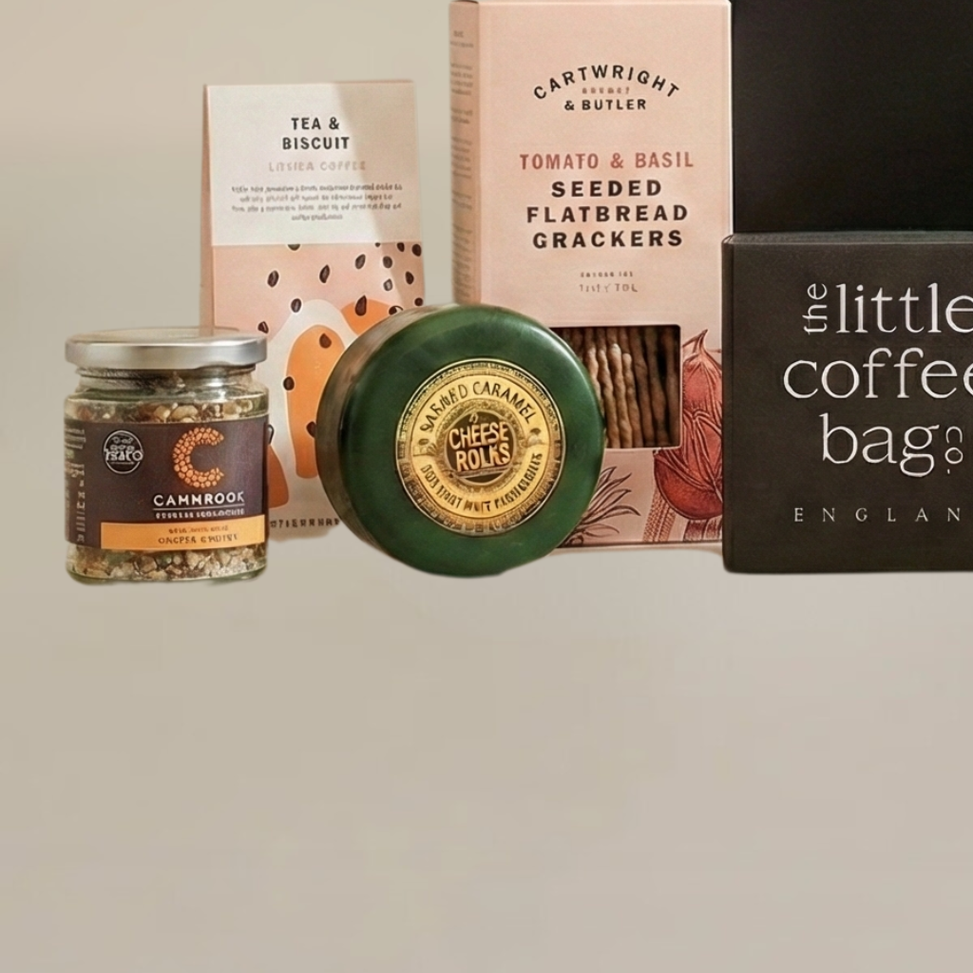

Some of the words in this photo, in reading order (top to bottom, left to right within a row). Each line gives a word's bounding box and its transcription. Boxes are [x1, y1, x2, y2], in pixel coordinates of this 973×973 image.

[533, 64, 680, 100] CARTWRIGHT
[564, 100, 575, 111] &
[581, 99, 647, 110] BUTLER
[291, 117, 321, 130] TEA
[328, 116, 340, 130] &
[282, 136, 350, 150] BISCUIT
[520, 153, 599, 170] TOMATO
[610, 153, 624, 169] &
[635, 152, 694, 168] BASIL
[551, 179, 662, 198] SEEDED
[526, 205, 688, 223] FLATBREAD
[802, 283, 828, 335] the
[472, 381, 536, 424] CARAMEL
[819, 412, 940, 477] bag
